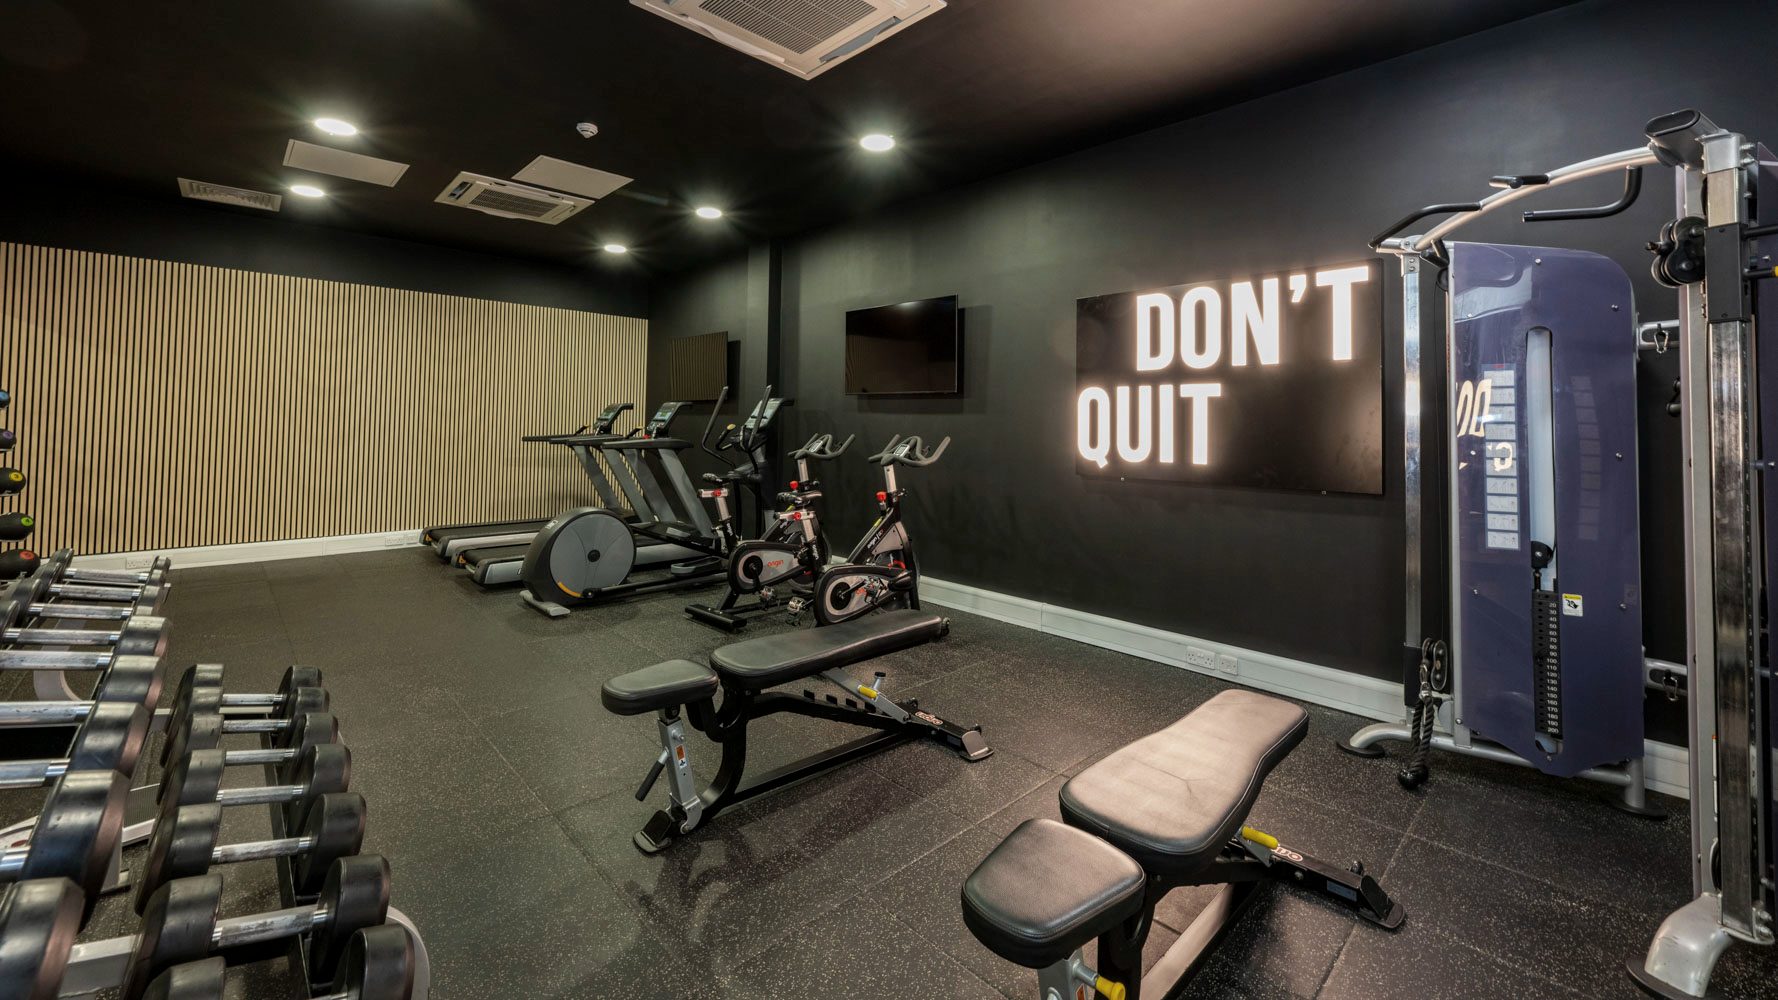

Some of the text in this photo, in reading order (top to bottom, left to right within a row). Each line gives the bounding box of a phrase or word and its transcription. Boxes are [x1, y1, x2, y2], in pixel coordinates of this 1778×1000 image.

[1136, 265, 1369, 371] DON'T
[1077, 383, 1222, 469] QUIT
[767, 559, 784, 568] origin
